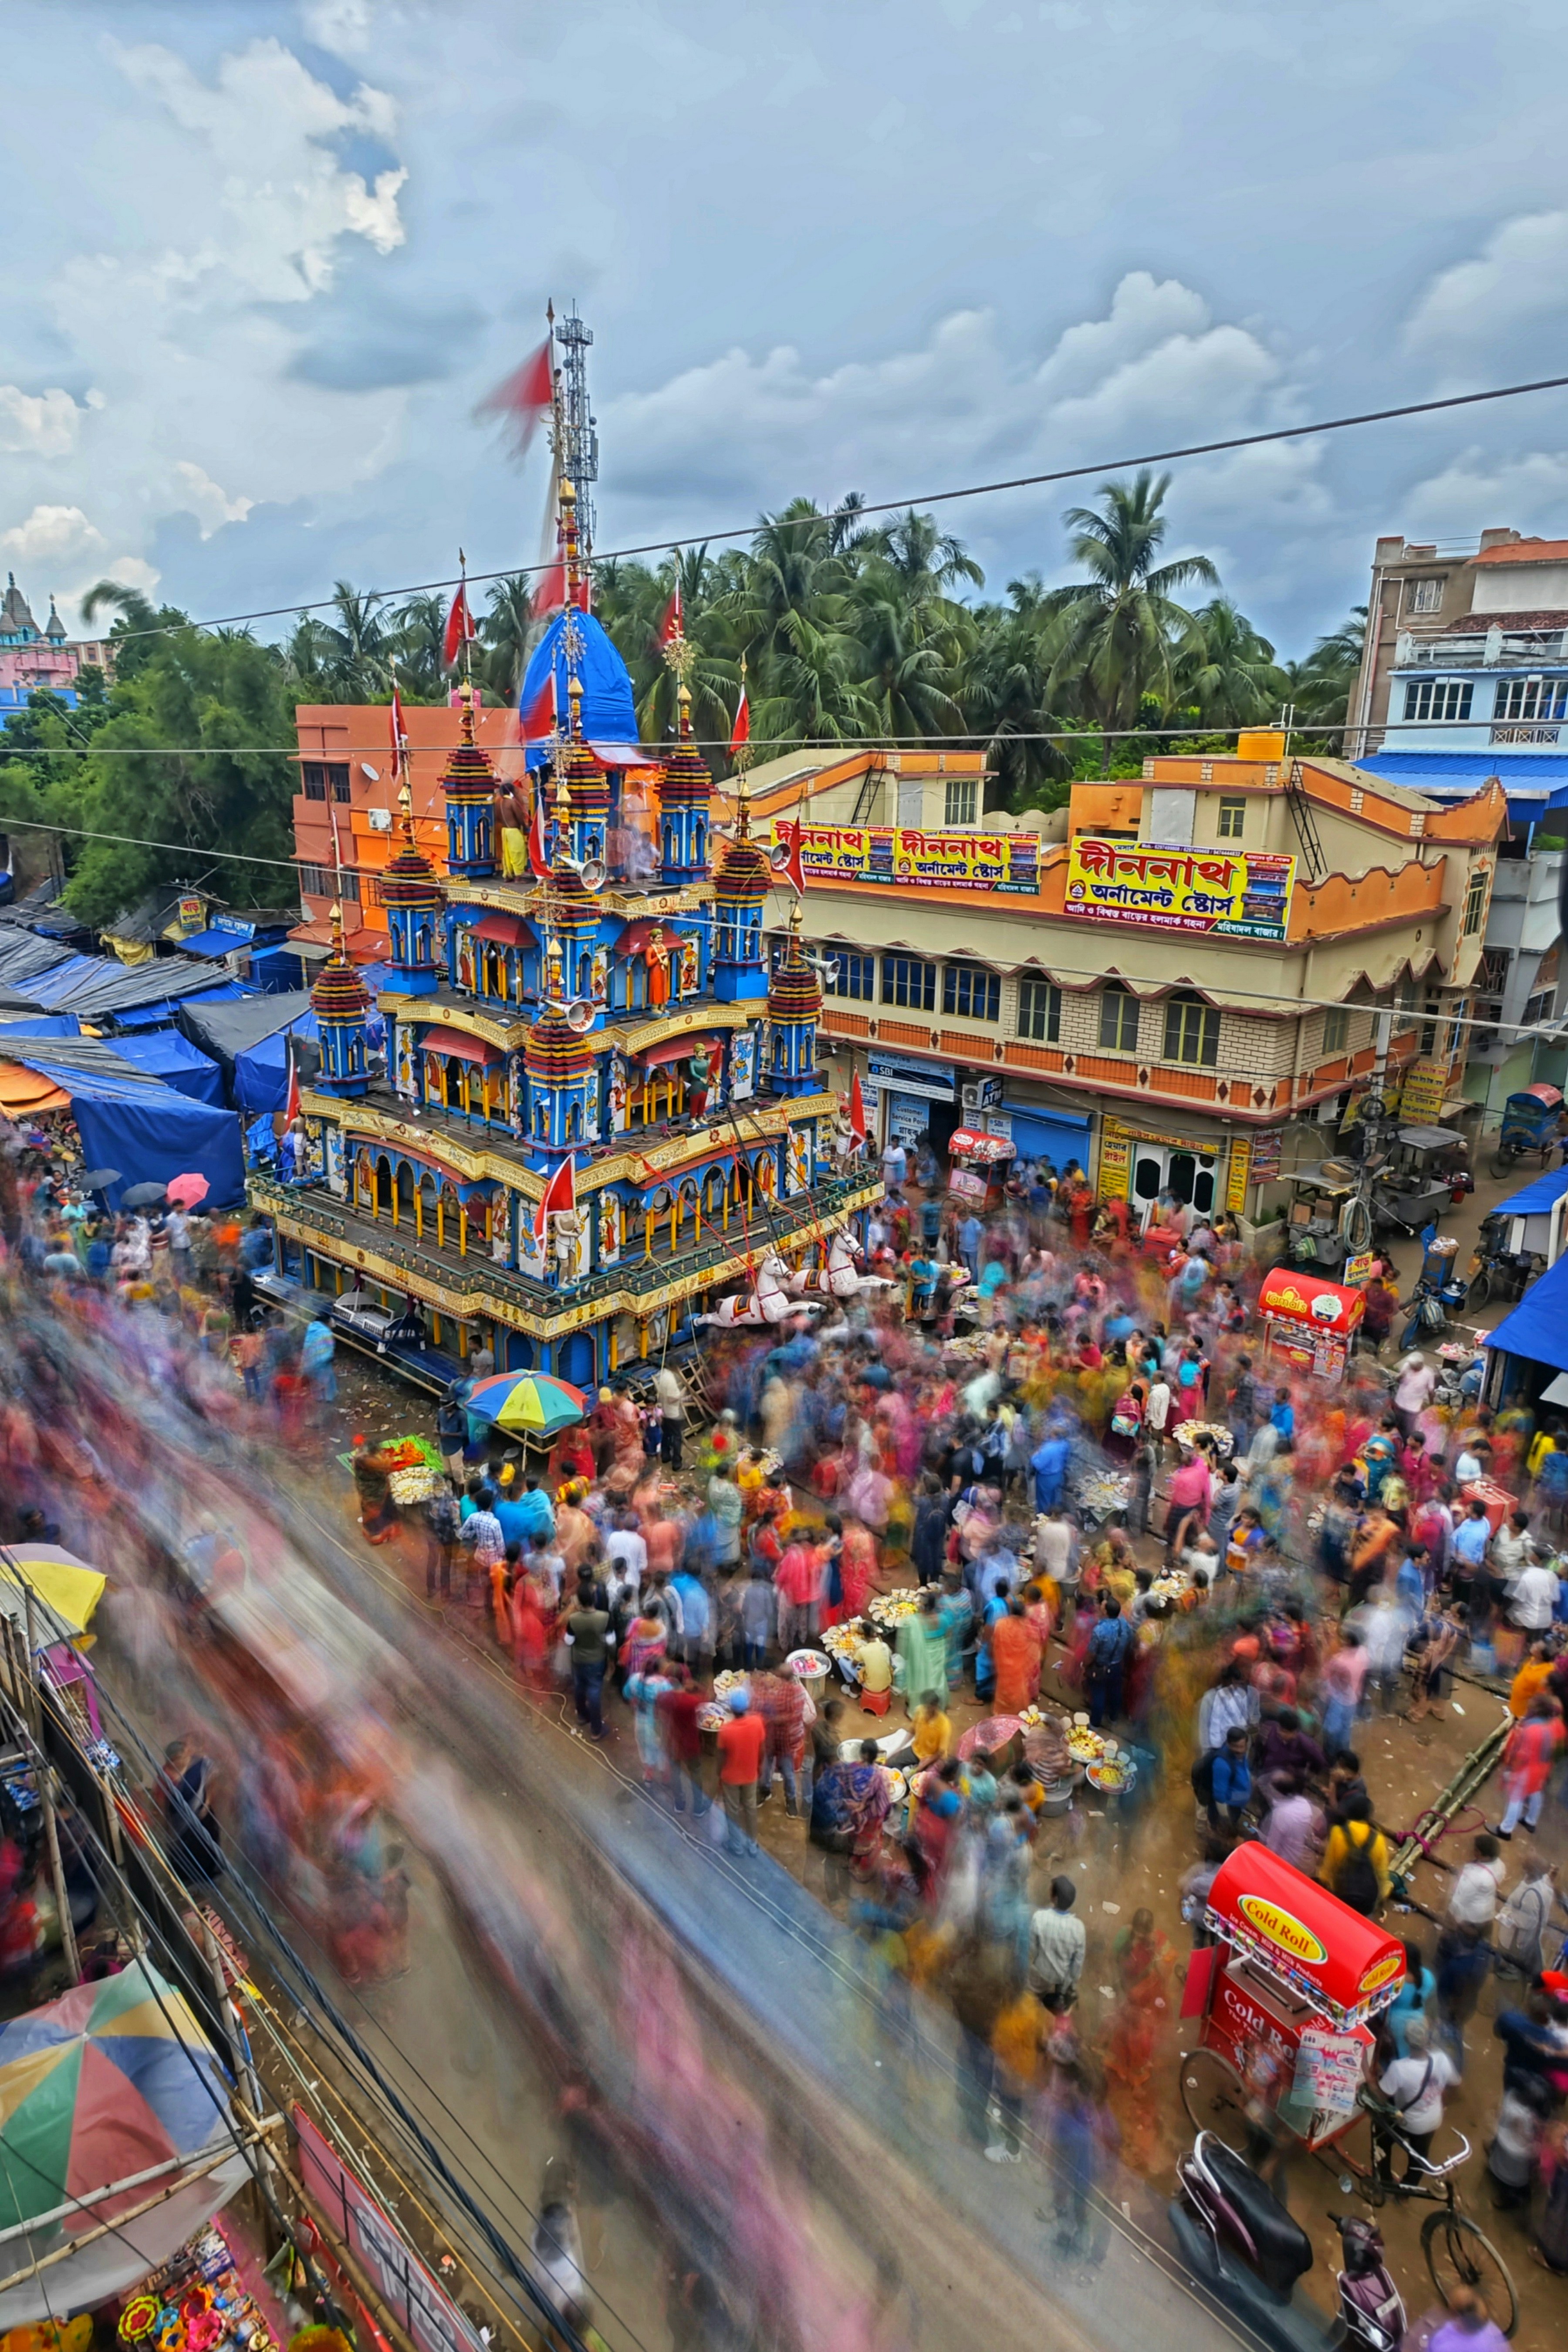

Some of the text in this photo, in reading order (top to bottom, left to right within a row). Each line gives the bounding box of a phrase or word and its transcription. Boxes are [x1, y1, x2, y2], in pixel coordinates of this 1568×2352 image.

[898, 829, 1004, 862] দীননাথ
[1075, 840, 1239, 892] দীননাথ
[1090, 883, 1176, 908] অর্নামেন্ট
[1066, 904, 1085, 914] আদি
[1088, 907, 1094, 915] ও
[1150, 913, 1182, 926] হলমার্ক
[1183, 918, 1206, 929] গহনা
[1216, 921, 1252, 935] মহিষাদল
[879, 1066, 893, 1077] SBI
[983, 1089, 1002, 1106] ATM
[892, 1112, 912, 1122] Service
[896, 1105, 923, 1116] Customer
[1105, 1141, 1127, 1152] হেয়ার
[1247, 1901, 1309, 1953] Cold Roll
[1229, 1913, 1239, 1924] Ice
[1240, 1919, 1259, 1940] Cream,
[1260, 1936, 1274, 1951] Milk
[1281, 1951, 1295, 1967] Milk
[1296, 1962, 1323, 1988] Products
[1362, 1962, 1393, 1988] Cold Roll
[1224, 1990, 1265, 2034] Cold
[1228, 2007, 1241, 2023] The
